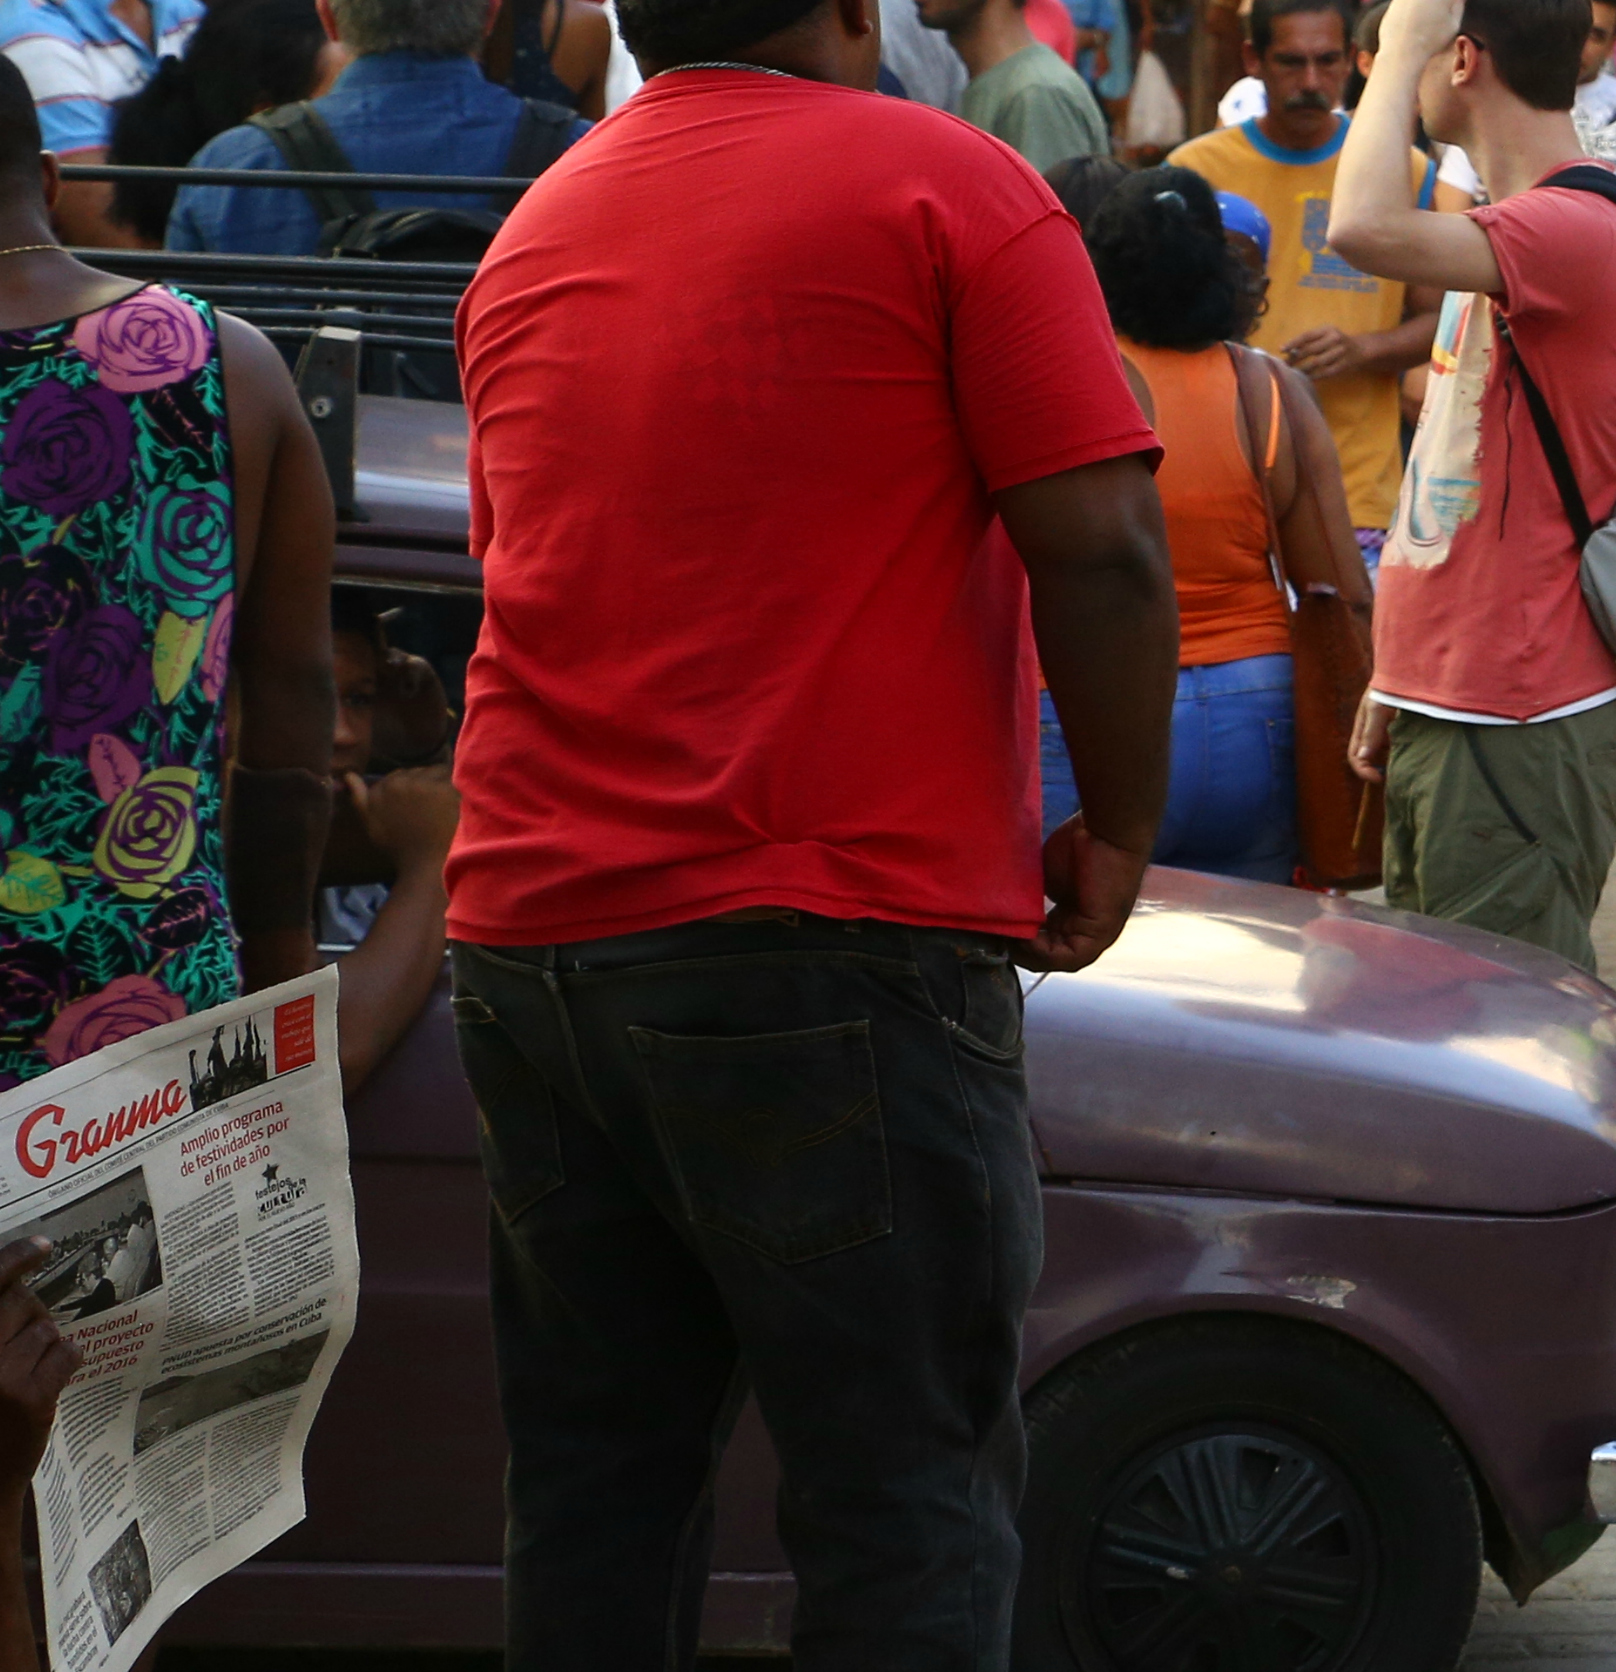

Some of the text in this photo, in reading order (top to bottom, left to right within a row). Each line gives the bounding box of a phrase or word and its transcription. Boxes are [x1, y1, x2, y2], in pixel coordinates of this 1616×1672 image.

[15, 1079, 187, 1178] Granma
[180, 1101, 284, 1157] Amplio programa
[180, 1117, 290, 1177] de festividades por
[204, 1144, 270, 1186] el fin de año
[77, 1309, 138, 1340] Nacional
[93, 1322, 154, 1353] proyecto
[161, 1312, 322, 1374] ecosistemas montañosos en Cuba
[192, 1338, 234, 1356] apuesta
[234, 1329, 253, 1346] por
[253, 1305, 314, 1336] conservación
[315, 1297, 327, 1310] de
[81, 1340, 144, 1368] supuesto
[103, 1354, 138, 1374] 2016
